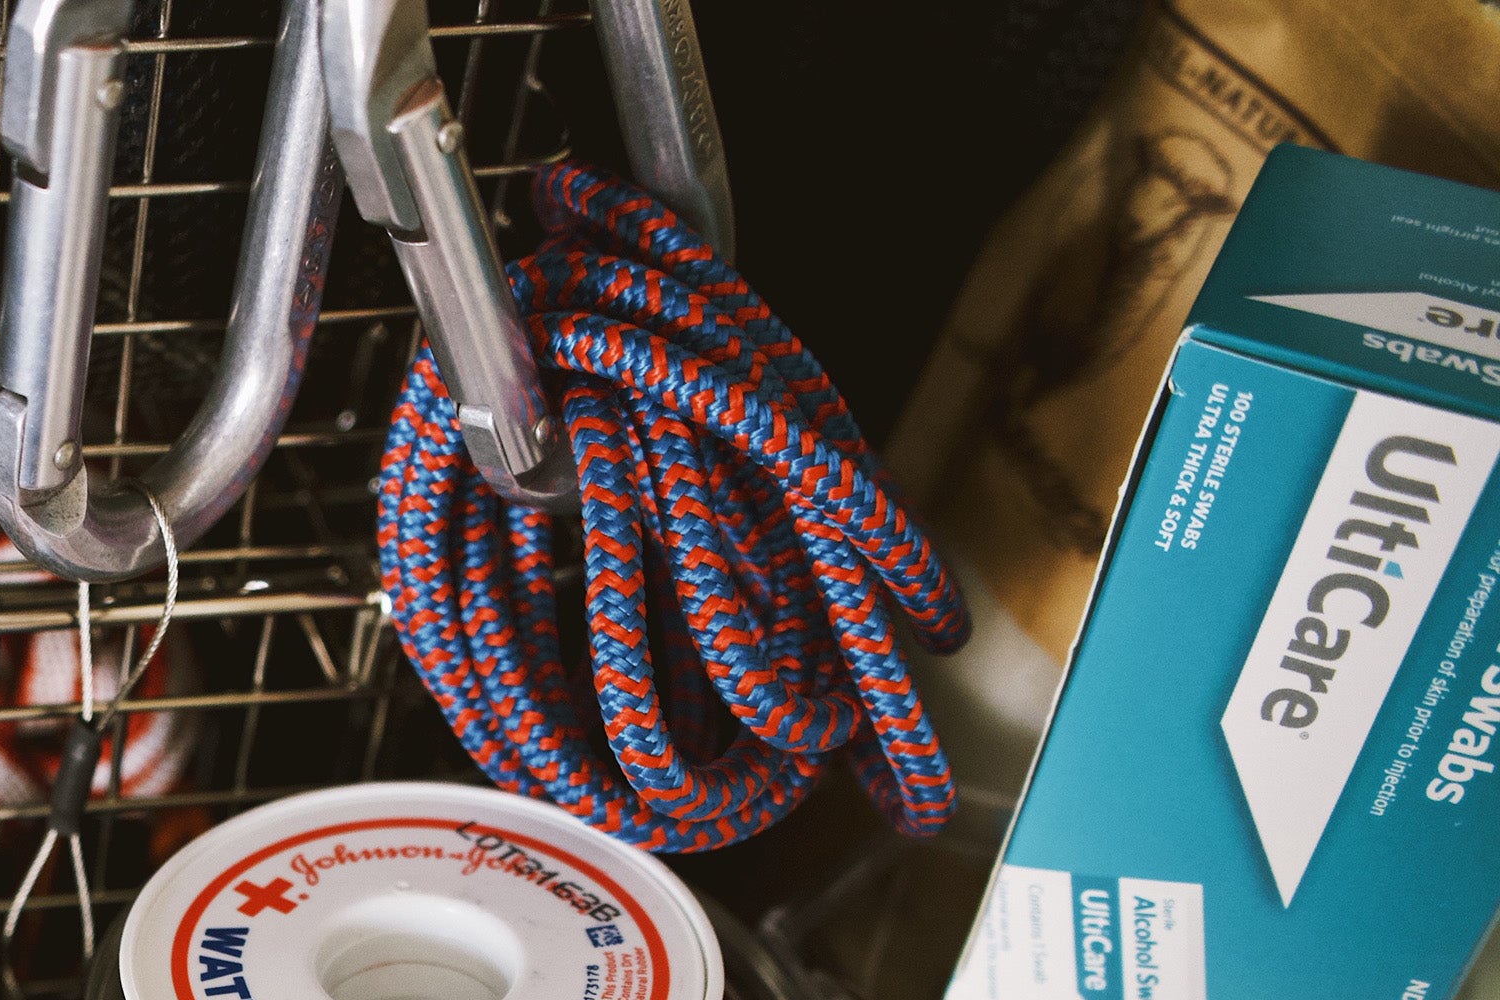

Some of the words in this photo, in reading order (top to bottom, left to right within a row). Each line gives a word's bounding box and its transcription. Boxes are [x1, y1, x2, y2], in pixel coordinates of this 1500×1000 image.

[1418, 272, 1479, 294] Alcohol
[1195, 381, 1230, 439] ULTRA
[1230, 391, 1254, 423] 100
[1175, 443, 1208, 495] THICK
[1203, 423, 1241, 491] STERILE
[1169, 493, 1187, 507] &
[1154, 507, 1182, 553] SOFT
[1180, 490, 1215, 550] SWABS
[1448, 573, 1496, 660] preparation
[1438, 657, 1457, 680] of
[1424, 675, 1450, 709] skin
[1405, 705, 1433, 746] prior
[1399, 740, 1419, 760] to
[1369, 758, 1413, 817] injection
[1079, 888, 1113, 991] UltiCare
[1133, 895, 1158, 970] Alcohol
[603, 951, 617, 983] Product
[621, 953, 633, 968] Dry
[583, 964, 599, 1000] 173178
[601, 984, 617, 1000] This
